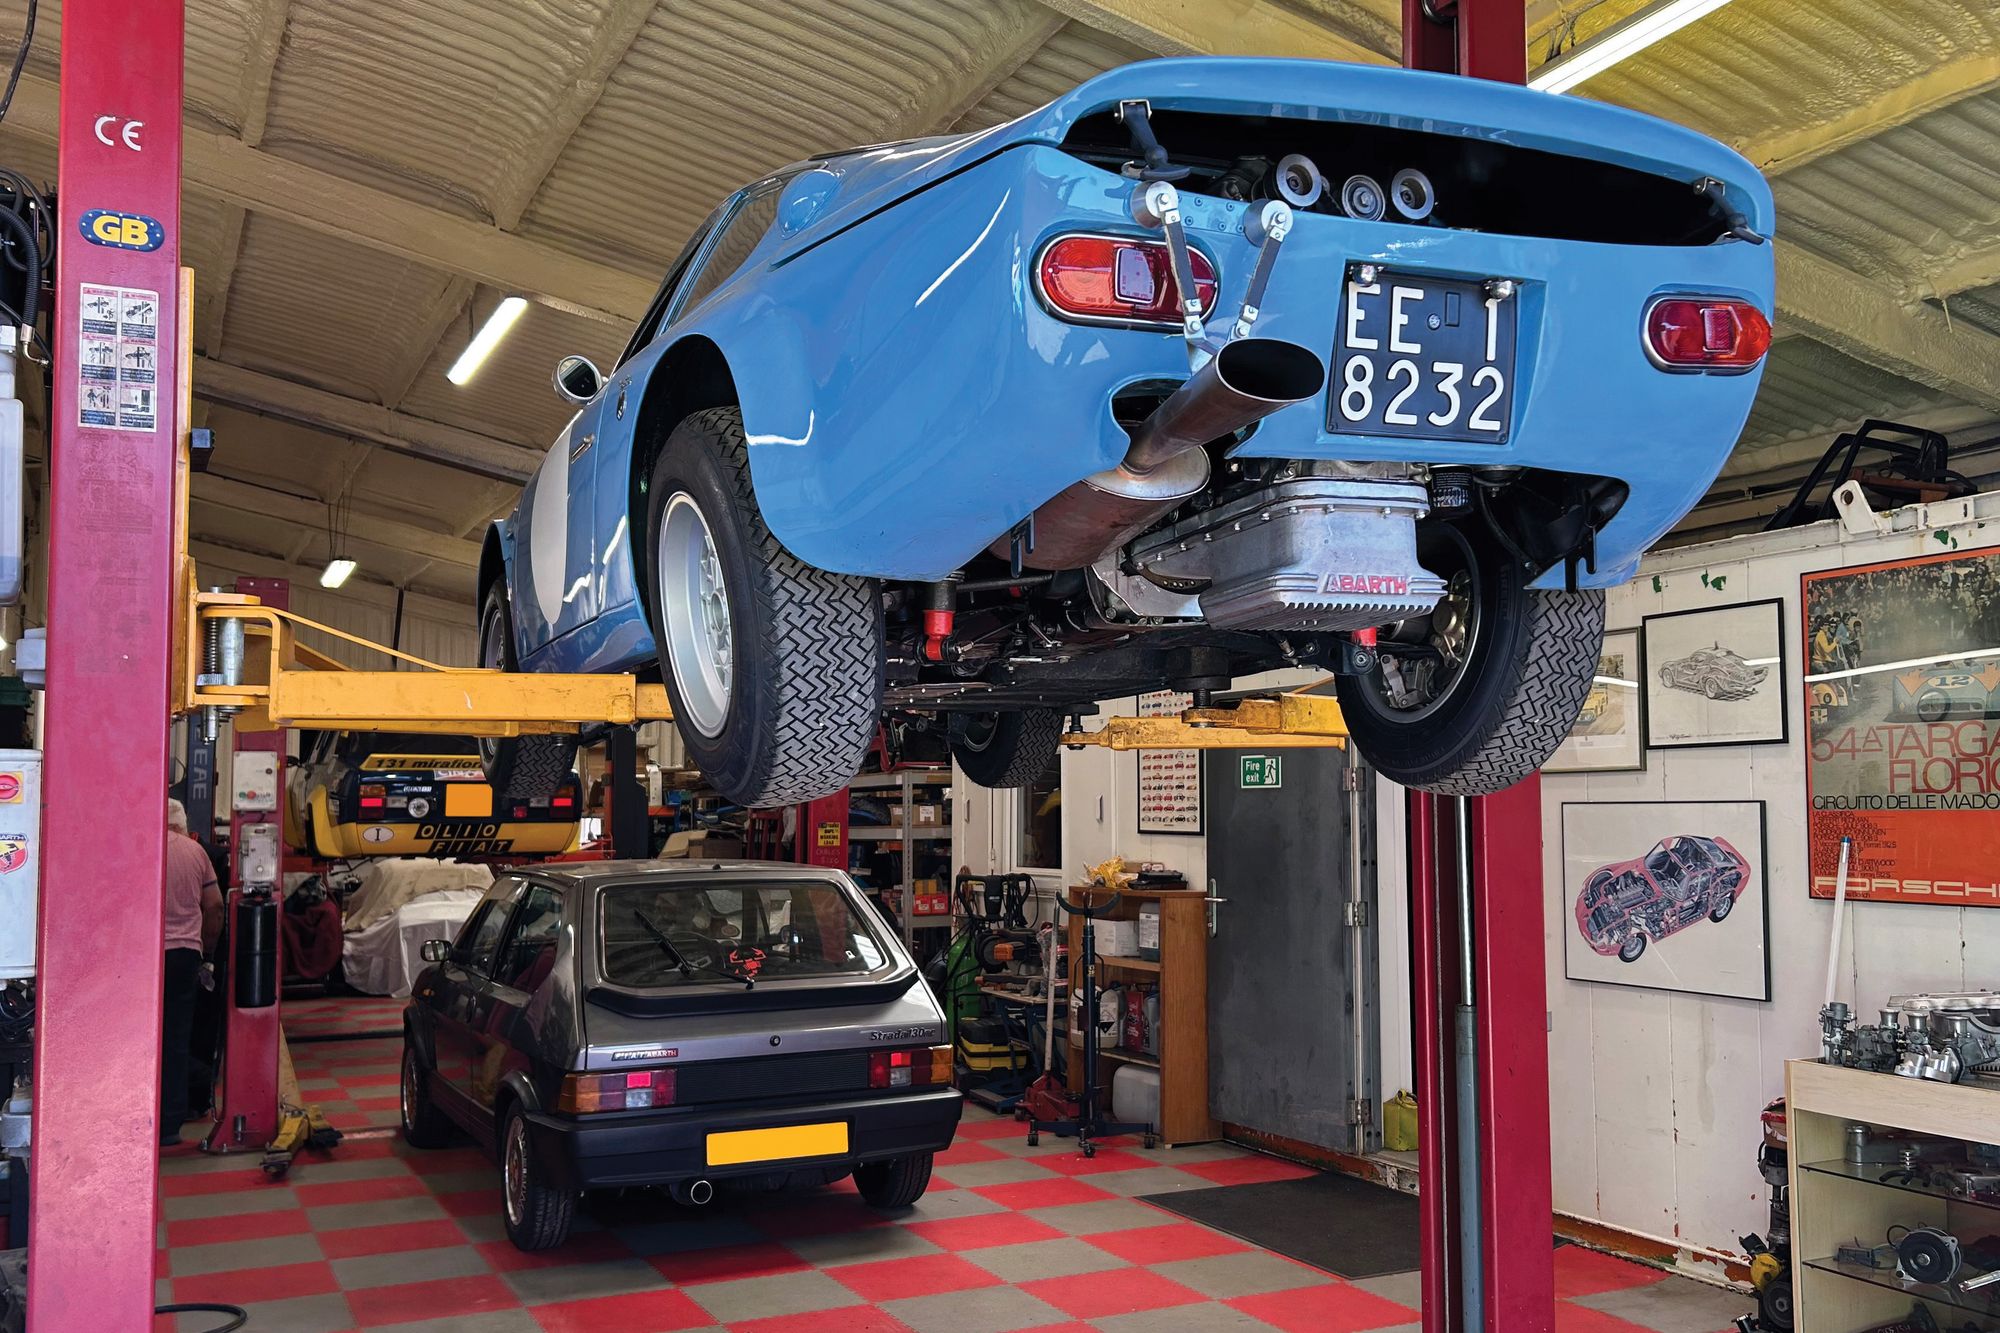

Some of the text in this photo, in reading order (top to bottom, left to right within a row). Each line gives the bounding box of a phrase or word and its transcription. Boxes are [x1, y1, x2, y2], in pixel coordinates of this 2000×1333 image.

[94, 116, 144, 152] CE
[92, 214, 149, 247] GB
[1340, 354, 1505, 432] 8232
[1326, 574, 1408, 595] ABARTH
[1935, 675, 1969, 687] 12
[376, 759, 406, 769] 131
[1246, 760, 1260, 771] Fire
[1246, 772, 1260, 783] exit
[1812, 794, 1882, 810] CIRCUITO
[1887, 794, 1936, 810] DELLE
[421, 825, 496, 838] OLIO
[433, 841, 508, 852] FIAT
[1814, 876, 2000, 898] PORSCH
